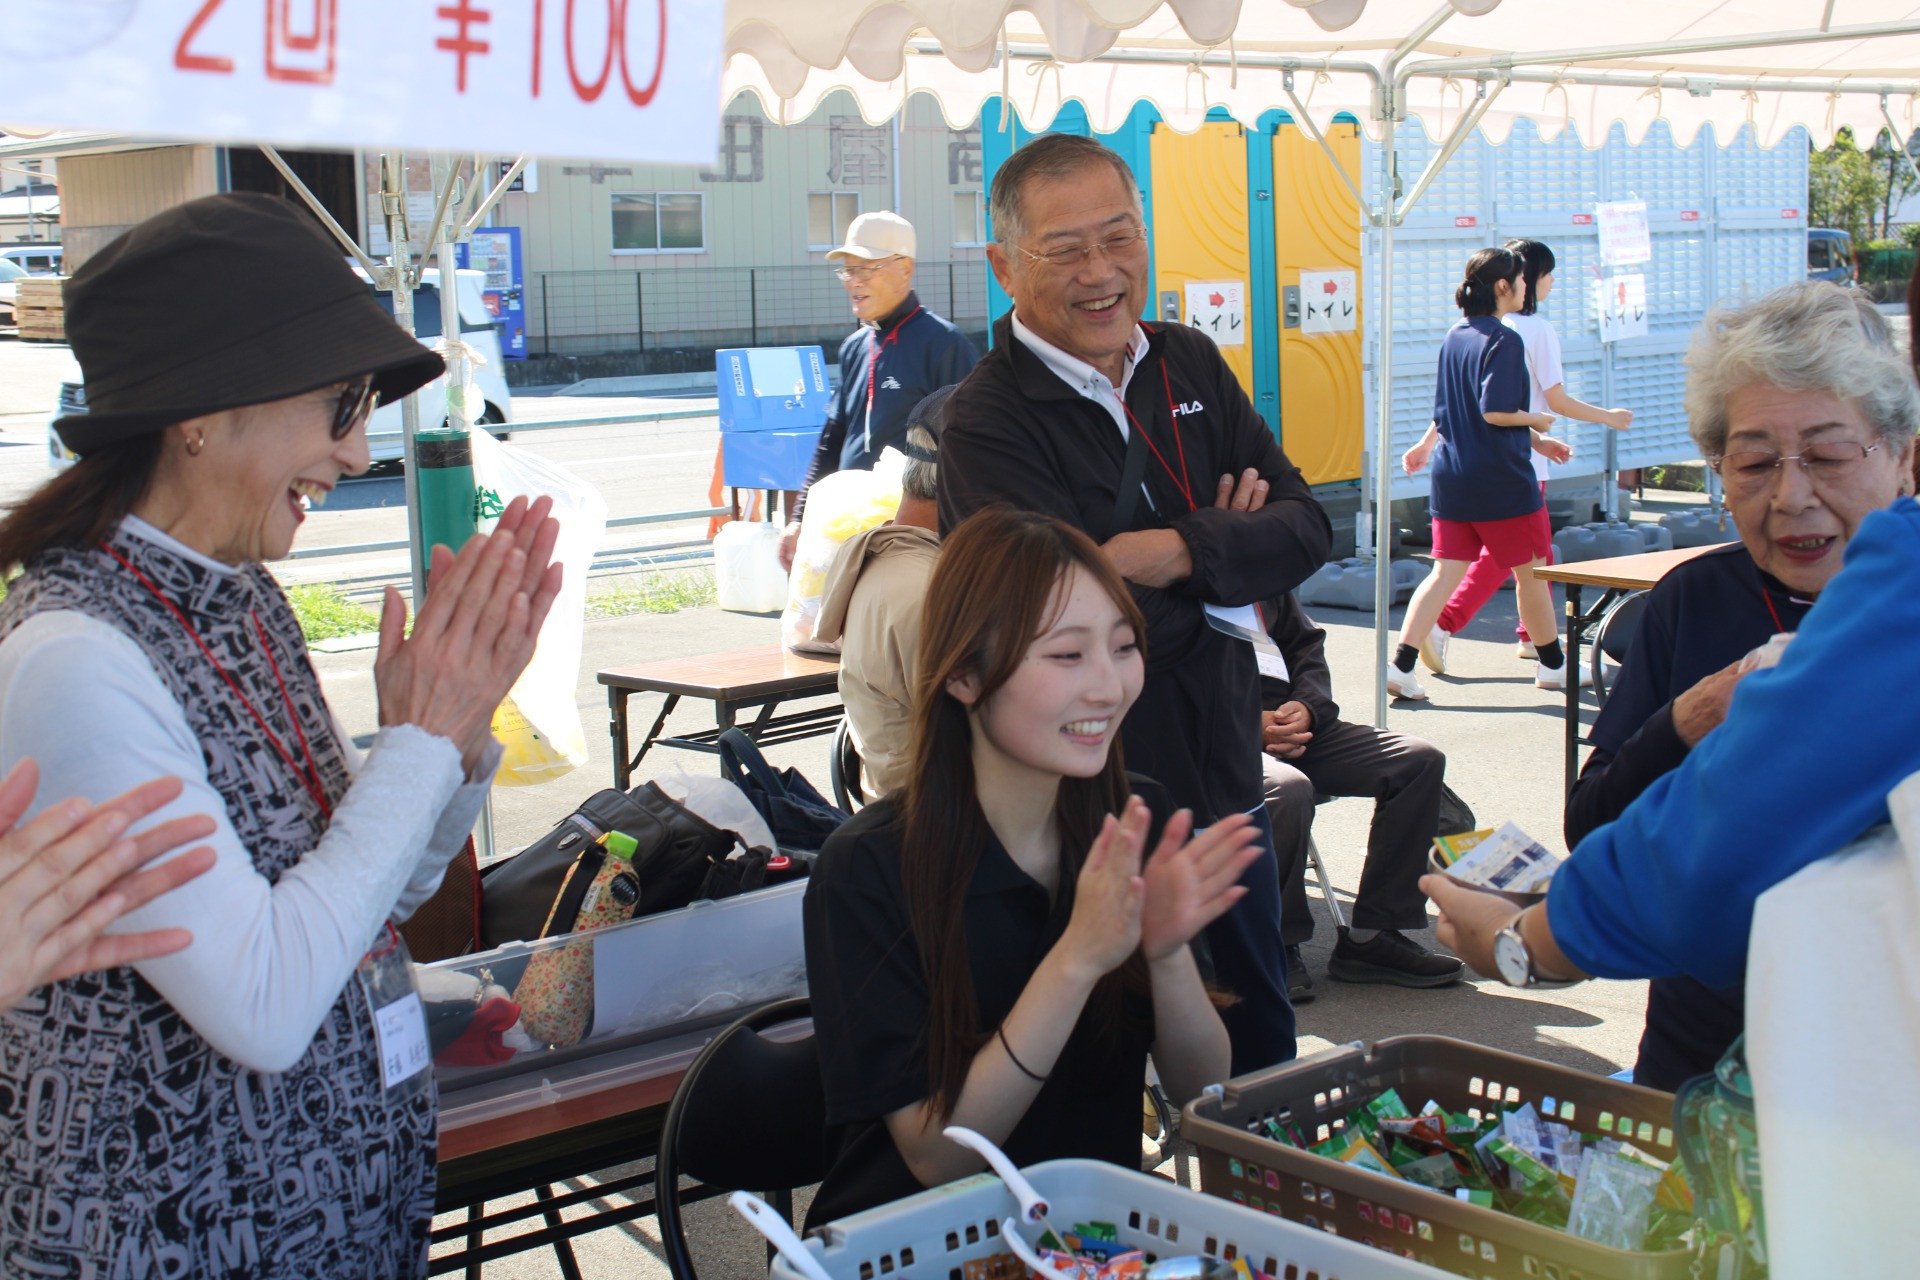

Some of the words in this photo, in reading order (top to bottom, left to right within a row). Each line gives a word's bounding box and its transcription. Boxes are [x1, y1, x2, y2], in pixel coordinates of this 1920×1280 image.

[436, 0, 667, 107] ¥100
[1307, 300, 1353, 320] トイレ
[1603, 305, 1644, 328] トイレ
[1192, 313, 1241, 332] トイレ
[1172, 400, 1204, 417] FILA
